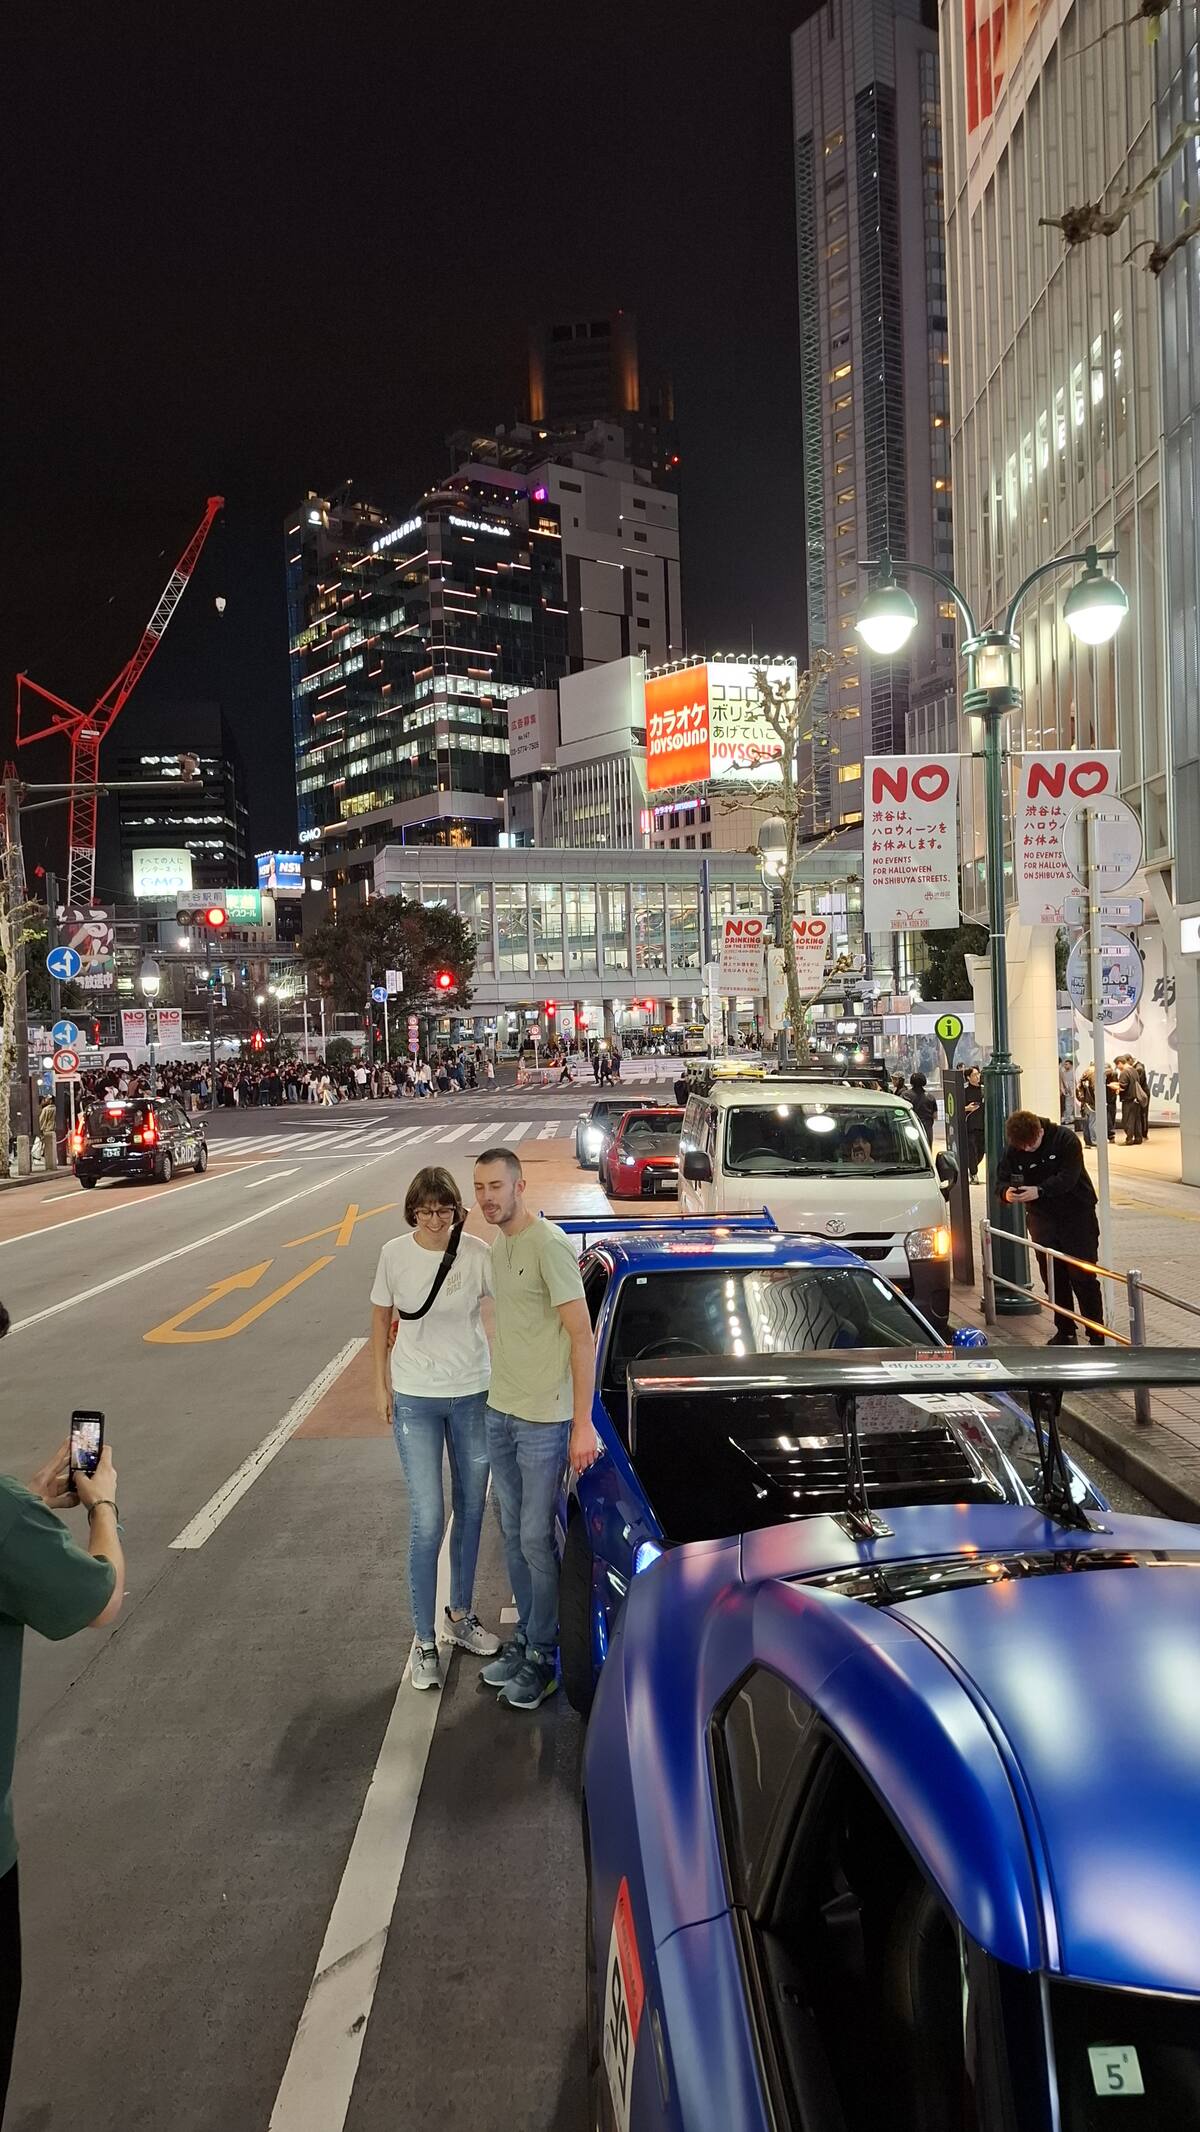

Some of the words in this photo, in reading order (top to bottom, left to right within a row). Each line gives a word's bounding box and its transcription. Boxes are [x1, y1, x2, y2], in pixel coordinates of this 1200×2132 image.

[380, 516, 422, 549] FUKURAS
[448, 515, 480, 530] TOKYU
[480, 523, 511, 537] PLAZA
[650, 703, 706, 738] カラオケ
[650, 728, 708, 756] JOYSOUND
[872, 764, 950, 804] NO
[1027, 761, 1109, 799] NO
[872, 810, 913, 822] 渋谷は、
[1025, 805, 1067, 817] 渋谷は、
[299, 827, 321, 843] GMO
[872, 822, 948, 836] ハロウィーンを
[872, 838, 943, 851] お休みします。
[139, 856, 184, 866] すべての人に
[885, 856, 912, 864] EVENTS
[1036, 851, 1062, 859] EVENTS
[873, 867, 887, 875] FOR
[888, 865, 932, 874] HALLOWEEN
[1038, 861, 1068, 869] HALLOW
[872, 877, 884, 885] ON
[885, 876, 917, 885] SHIBUYA
[917, 874, 950, 883] STREETS.
[1024, 872, 1034, 880] ON
[1034, 871, 1066, 879] SHIBUYA
[726, 919, 763, 937] NO
[792, 920, 827, 937] NO
[123, 1012, 144, 1020] NO
[159, 1011, 180, 1019] NO
[1106, 2063, 1125, 2091] 5
